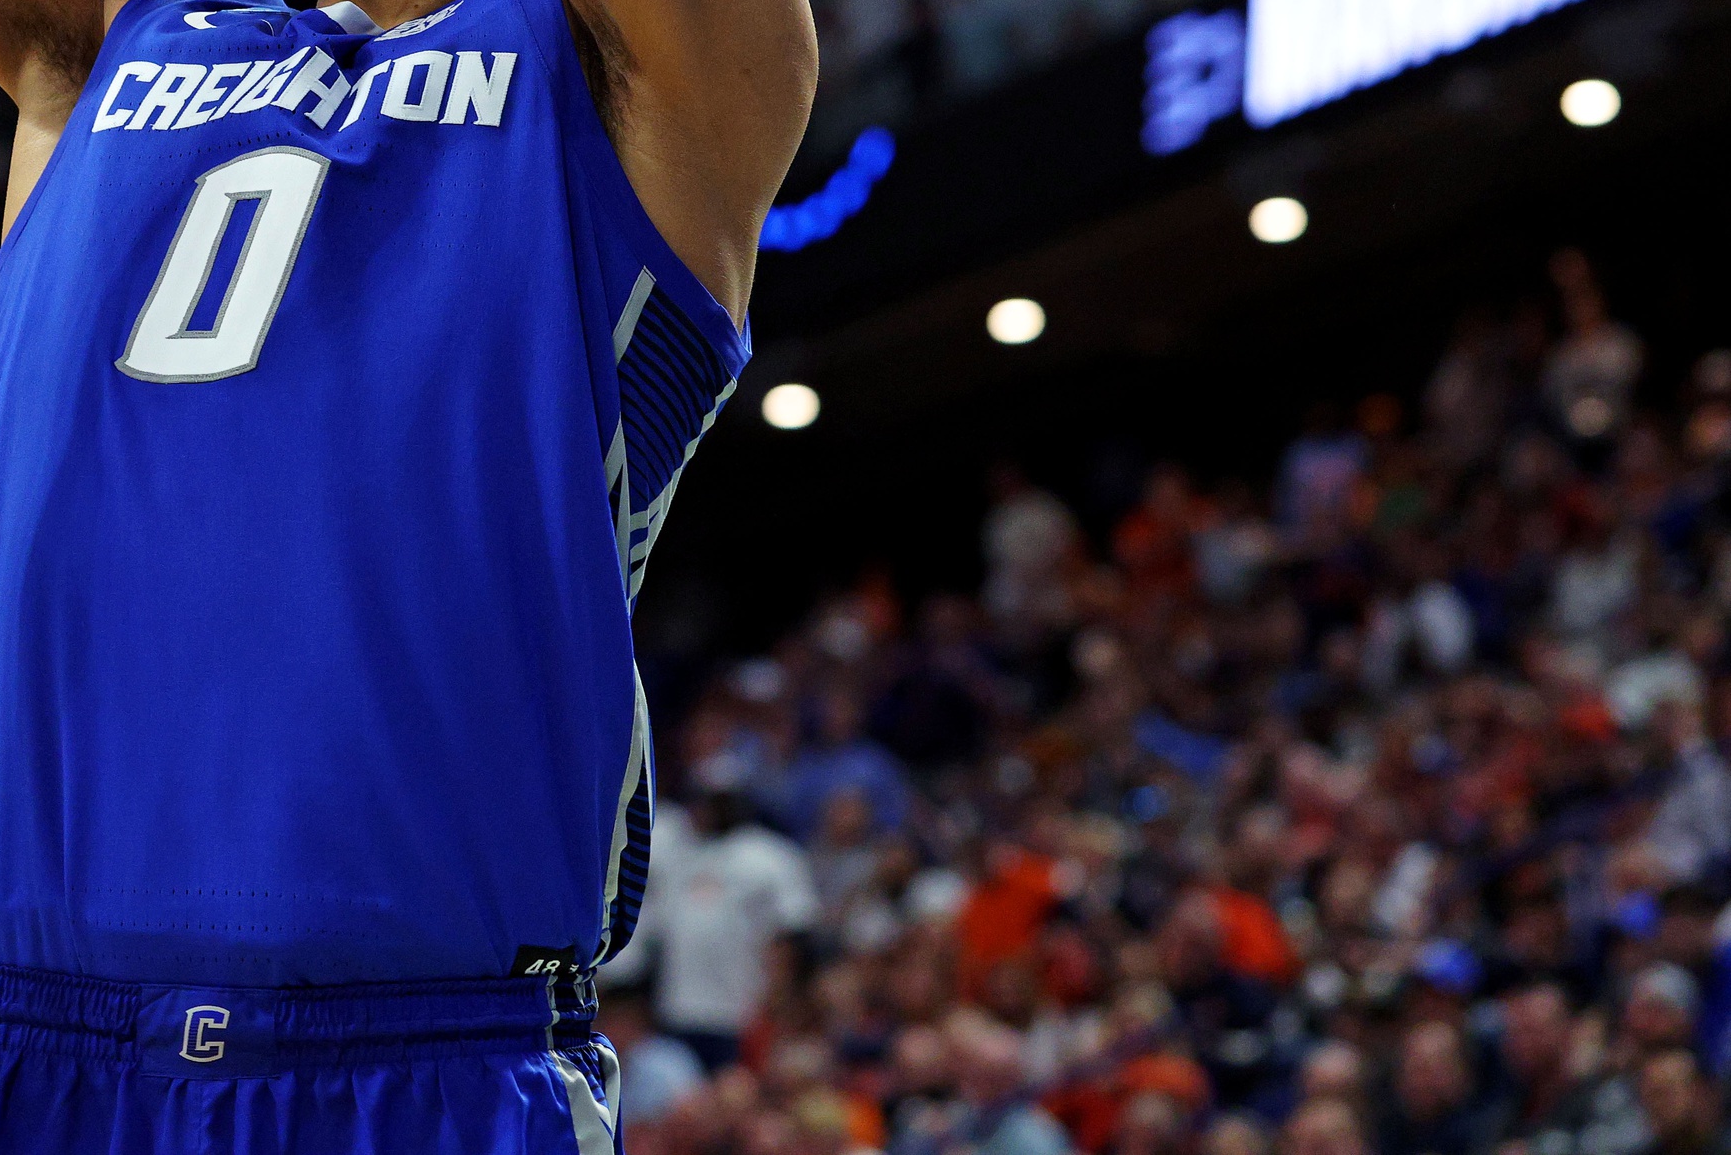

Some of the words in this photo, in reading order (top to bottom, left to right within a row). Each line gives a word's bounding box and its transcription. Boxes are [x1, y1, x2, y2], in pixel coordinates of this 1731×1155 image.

[92, 45, 518, 133] CREIGHTON
[114, 145, 332, 385] 0
[179, 1005, 232, 1063] C
